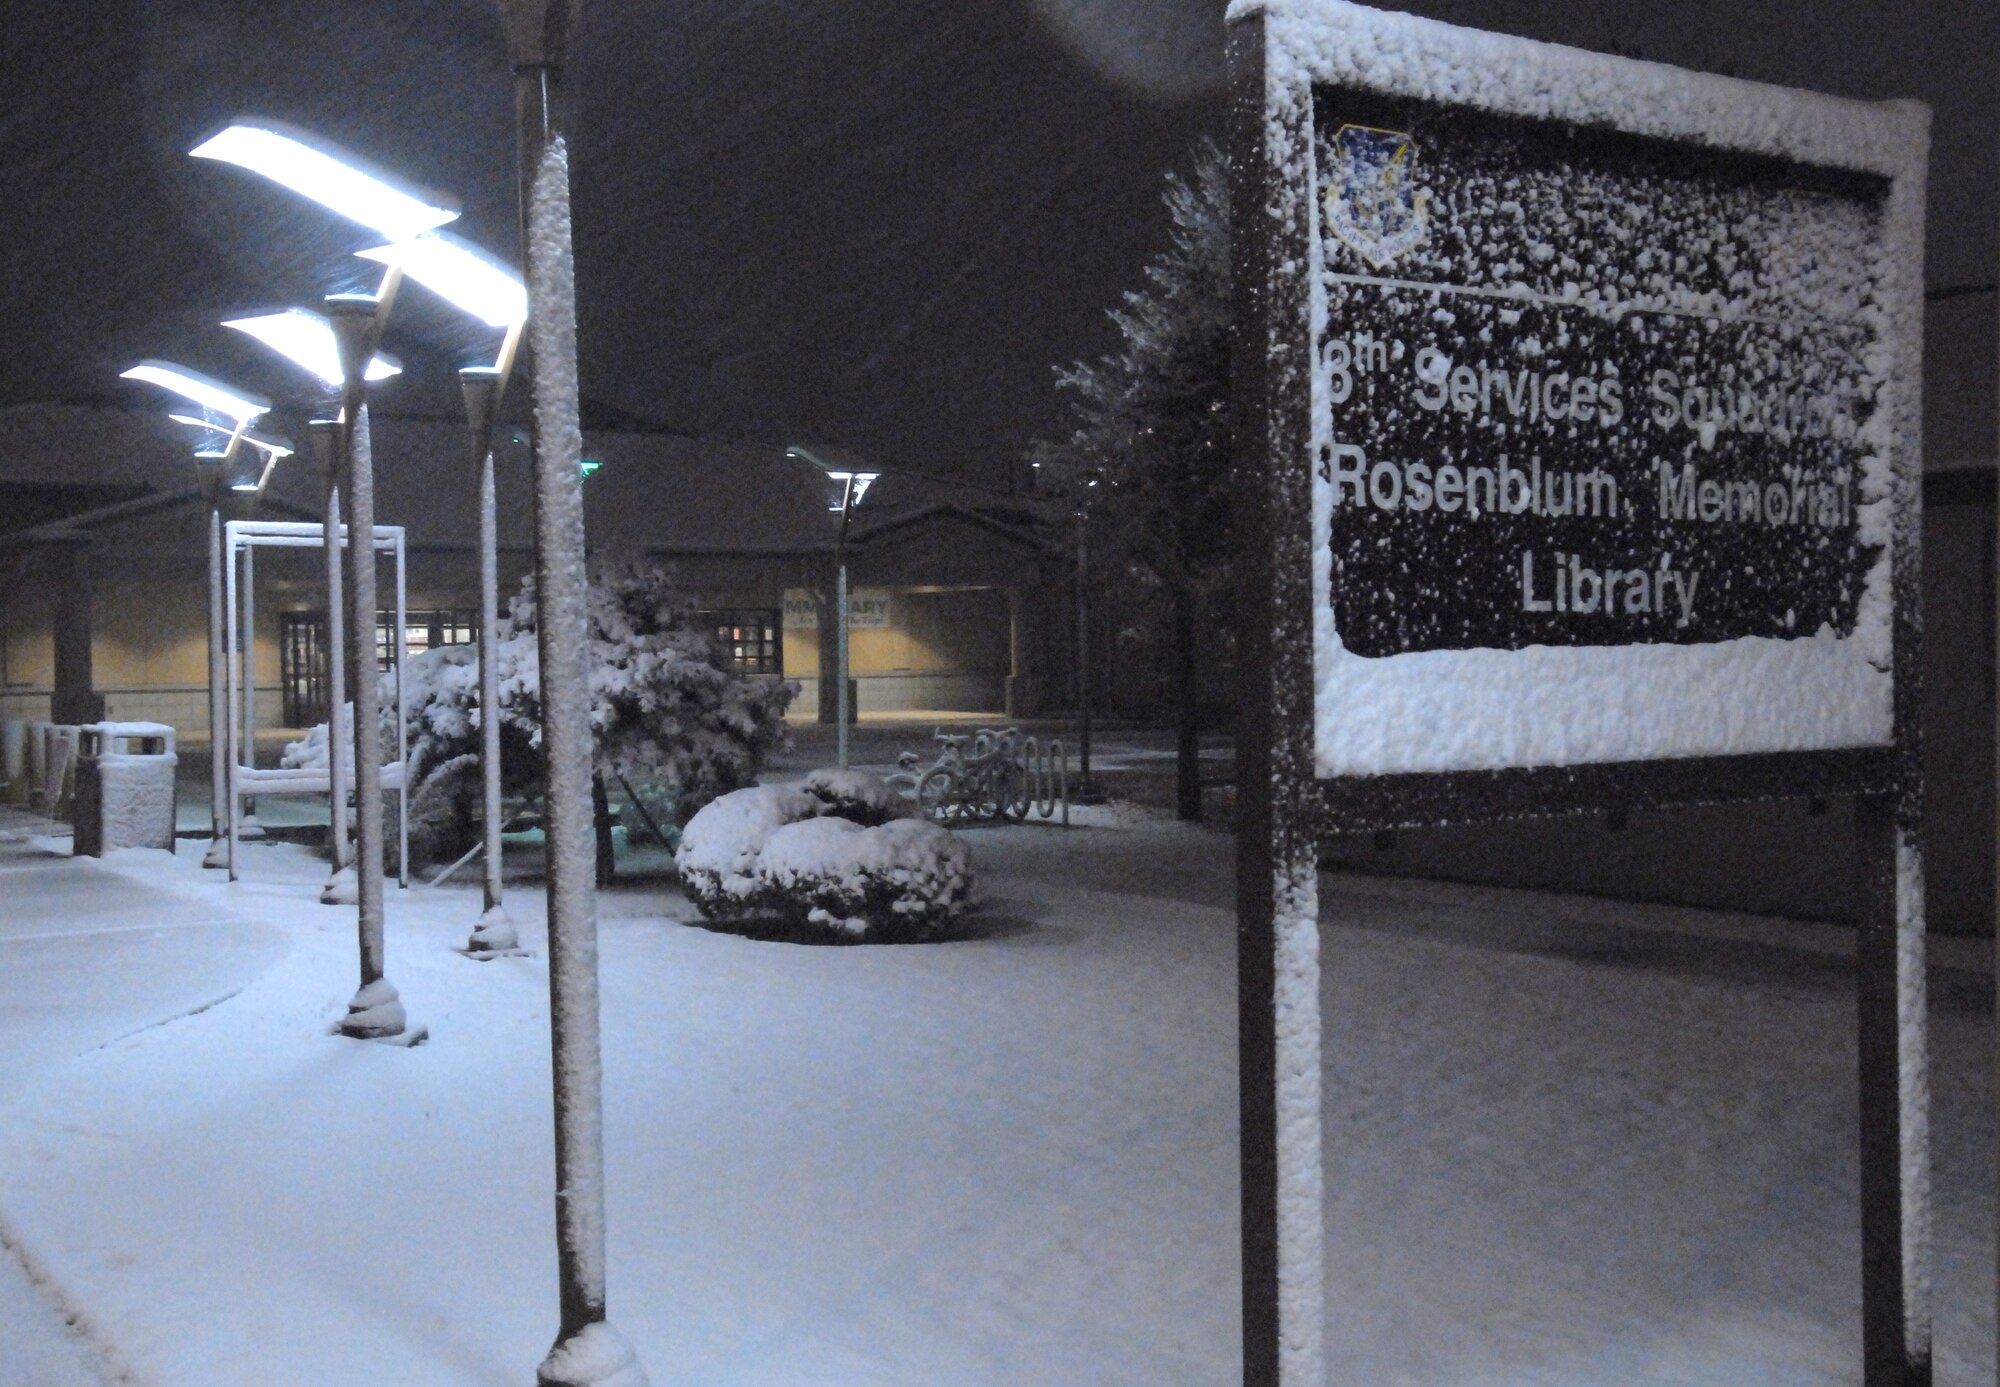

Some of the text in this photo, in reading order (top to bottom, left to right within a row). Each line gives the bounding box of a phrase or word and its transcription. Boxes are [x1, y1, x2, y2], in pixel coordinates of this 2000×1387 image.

[1415, 347, 1625, 426] Services
[1328, 444, 1850, 527] Rosenblum Memorial
[1522, 550, 1700, 629] Library
